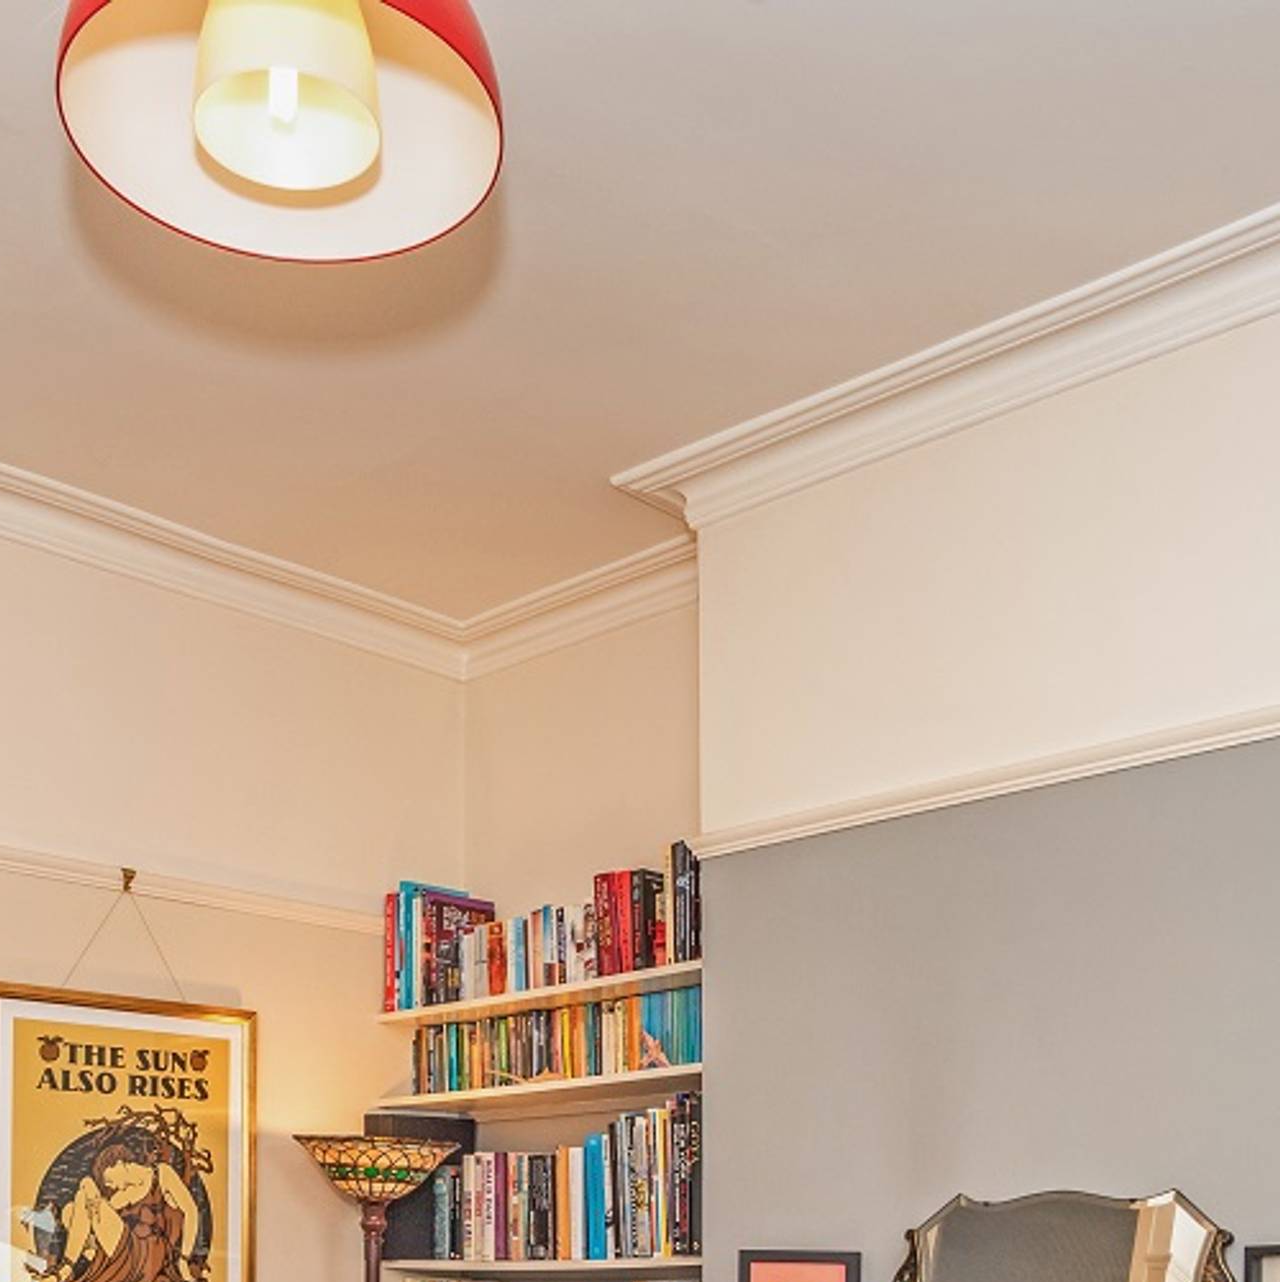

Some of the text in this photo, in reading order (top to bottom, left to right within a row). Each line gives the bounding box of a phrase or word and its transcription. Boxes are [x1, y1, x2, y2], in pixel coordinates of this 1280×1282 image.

[62, 1042, 188, 1073] THE SUN
[36, 1069, 210, 1101] ALSO RISES
